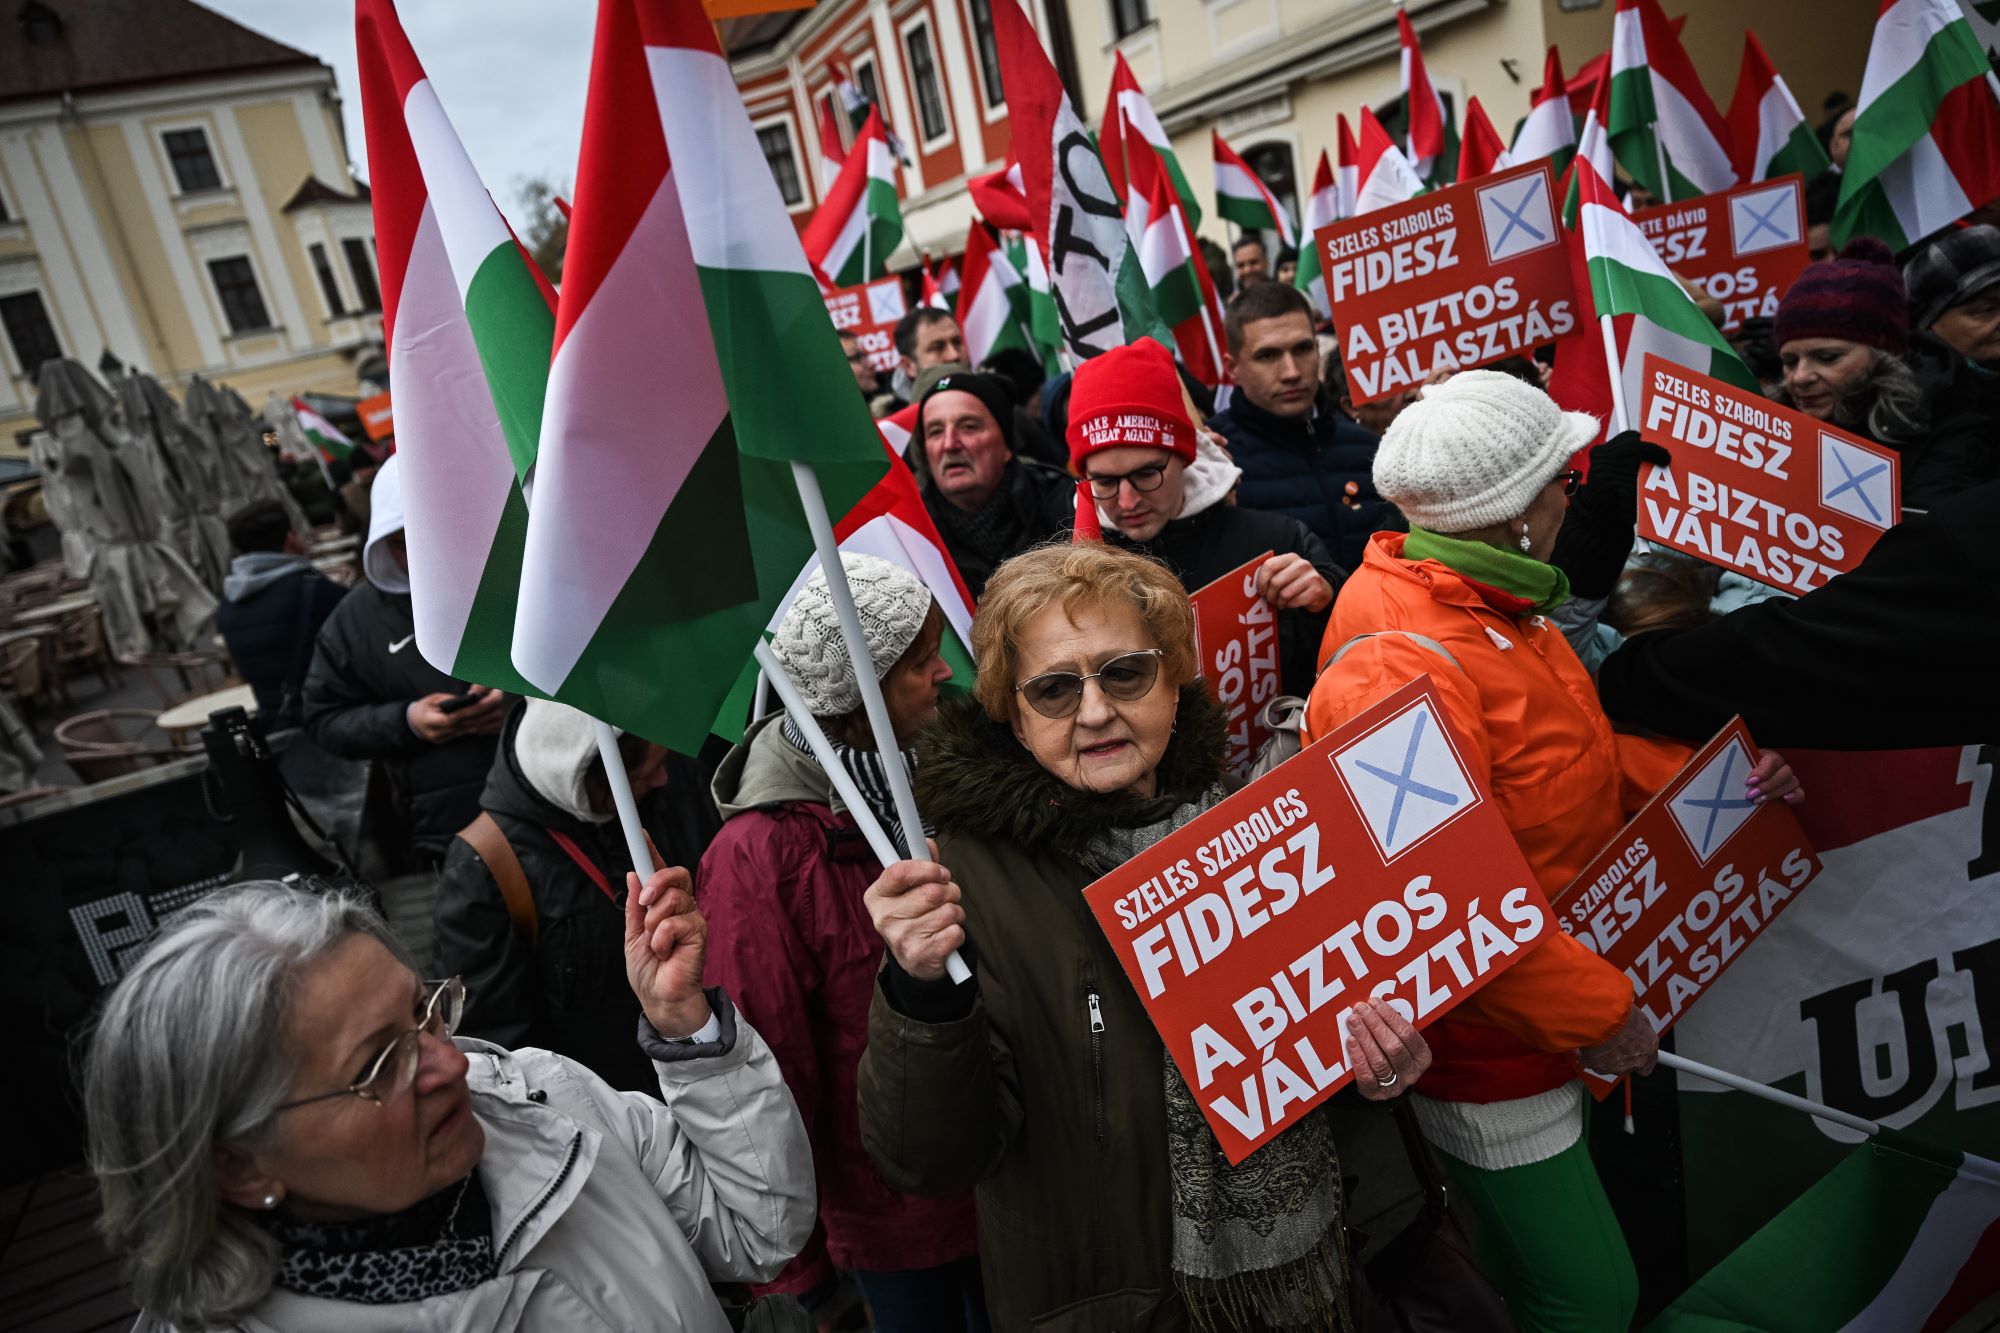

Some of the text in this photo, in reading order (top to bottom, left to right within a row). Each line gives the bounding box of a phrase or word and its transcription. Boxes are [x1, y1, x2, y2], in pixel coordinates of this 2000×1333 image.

[1328, 203, 1455, 260] SZELES SZABOLCS
[1666, 207, 1707, 231] DÁVID
[1332, 228, 1459, 303] FIDESZ
[1347, 276, 1519, 361] A BIZTOS
[1351, 299, 1574, 398] VÁLASZTÁS
[1081, 415, 1109, 438] MAKE
[1115, 415, 1161, 431] AMERICA
[1089, 428, 1154, 447] GREAT AGAIN
[1646, 394, 1793, 481] FIDESZ
[1654, 371, 1793, 441] SZELES SZABOLCS
[1644, 464, 1845, 562] A BIZTOS
[1114, 788, 1308, 930] SZELES SZABOLCS
[1571, 837, 1650, 922] SZABOLCS
[1131, 822, 1336, 1000] FIDESZ
[1190, 874, 1448, 1091] A BIZTOS
